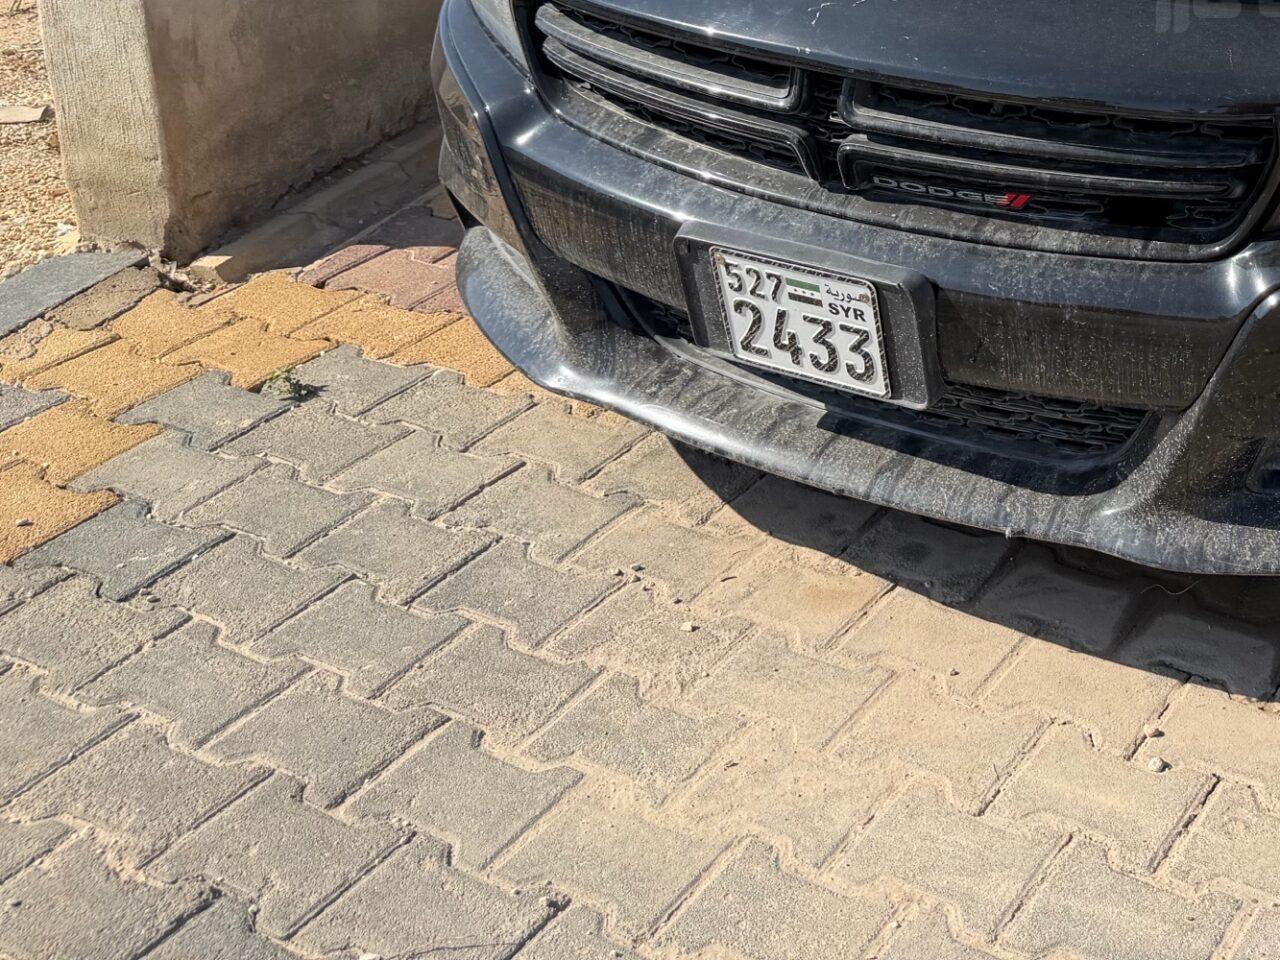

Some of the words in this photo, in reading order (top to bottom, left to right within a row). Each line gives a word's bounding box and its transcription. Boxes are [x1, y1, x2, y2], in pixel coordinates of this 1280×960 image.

[872, 176, 1010, 206] DODGE
[724, 262, 783, 303] 527
[828, 302, 866, 322] SYR
[733, 299, 875, 385] 2433
